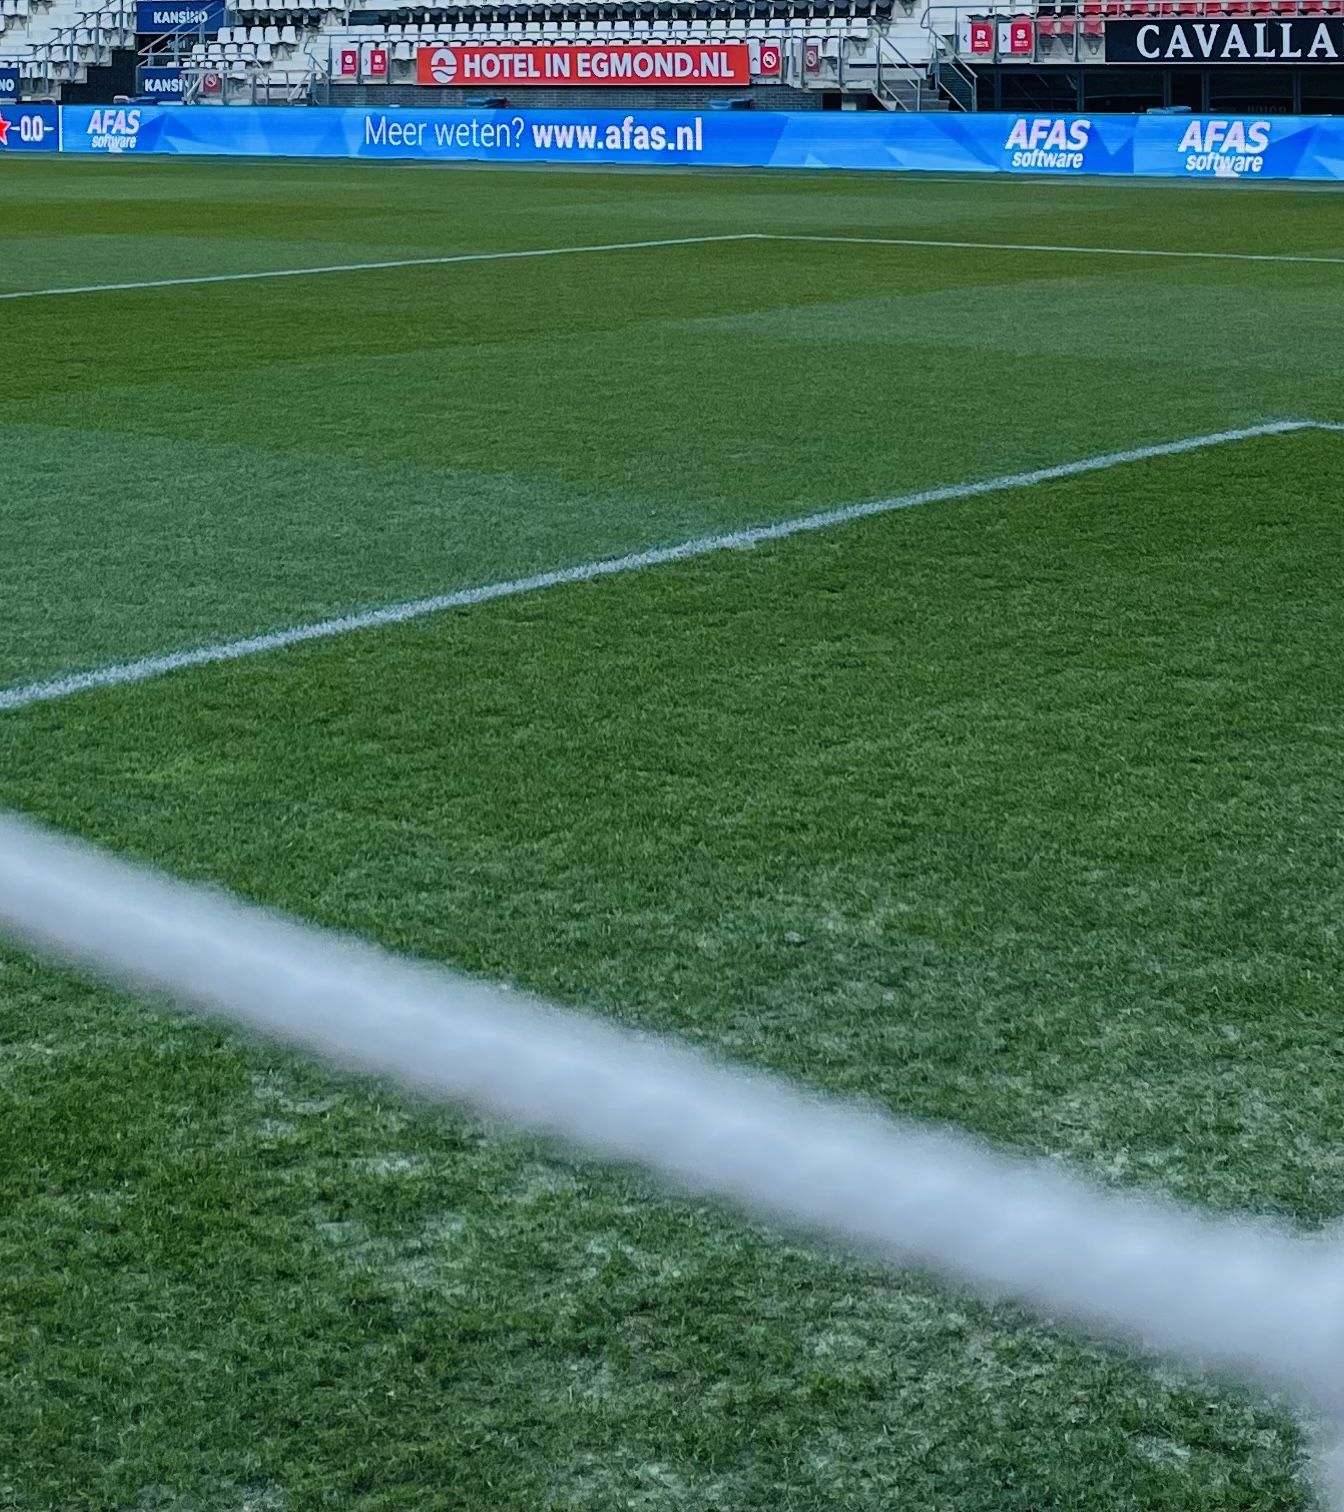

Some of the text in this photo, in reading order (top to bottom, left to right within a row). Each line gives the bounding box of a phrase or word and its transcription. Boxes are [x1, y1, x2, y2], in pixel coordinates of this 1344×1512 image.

[976, 29, 987, 40] R
[1016, 29, 1026, 39] S
[463, 51, 735, 79] HOTEL IN EGMOND.NL
[86, 109, 141, 135] AFAS
[365, 115, 703, 152] Meer weten? www.afas.nl
[91, 134, 137, 150] software
[1004, 119, 1091, 151] AFAS
[1178, 120, 1272, 153] AFAS
[1011, 149, 1084, 169] software
[1185, 152, 1263, 174] software
